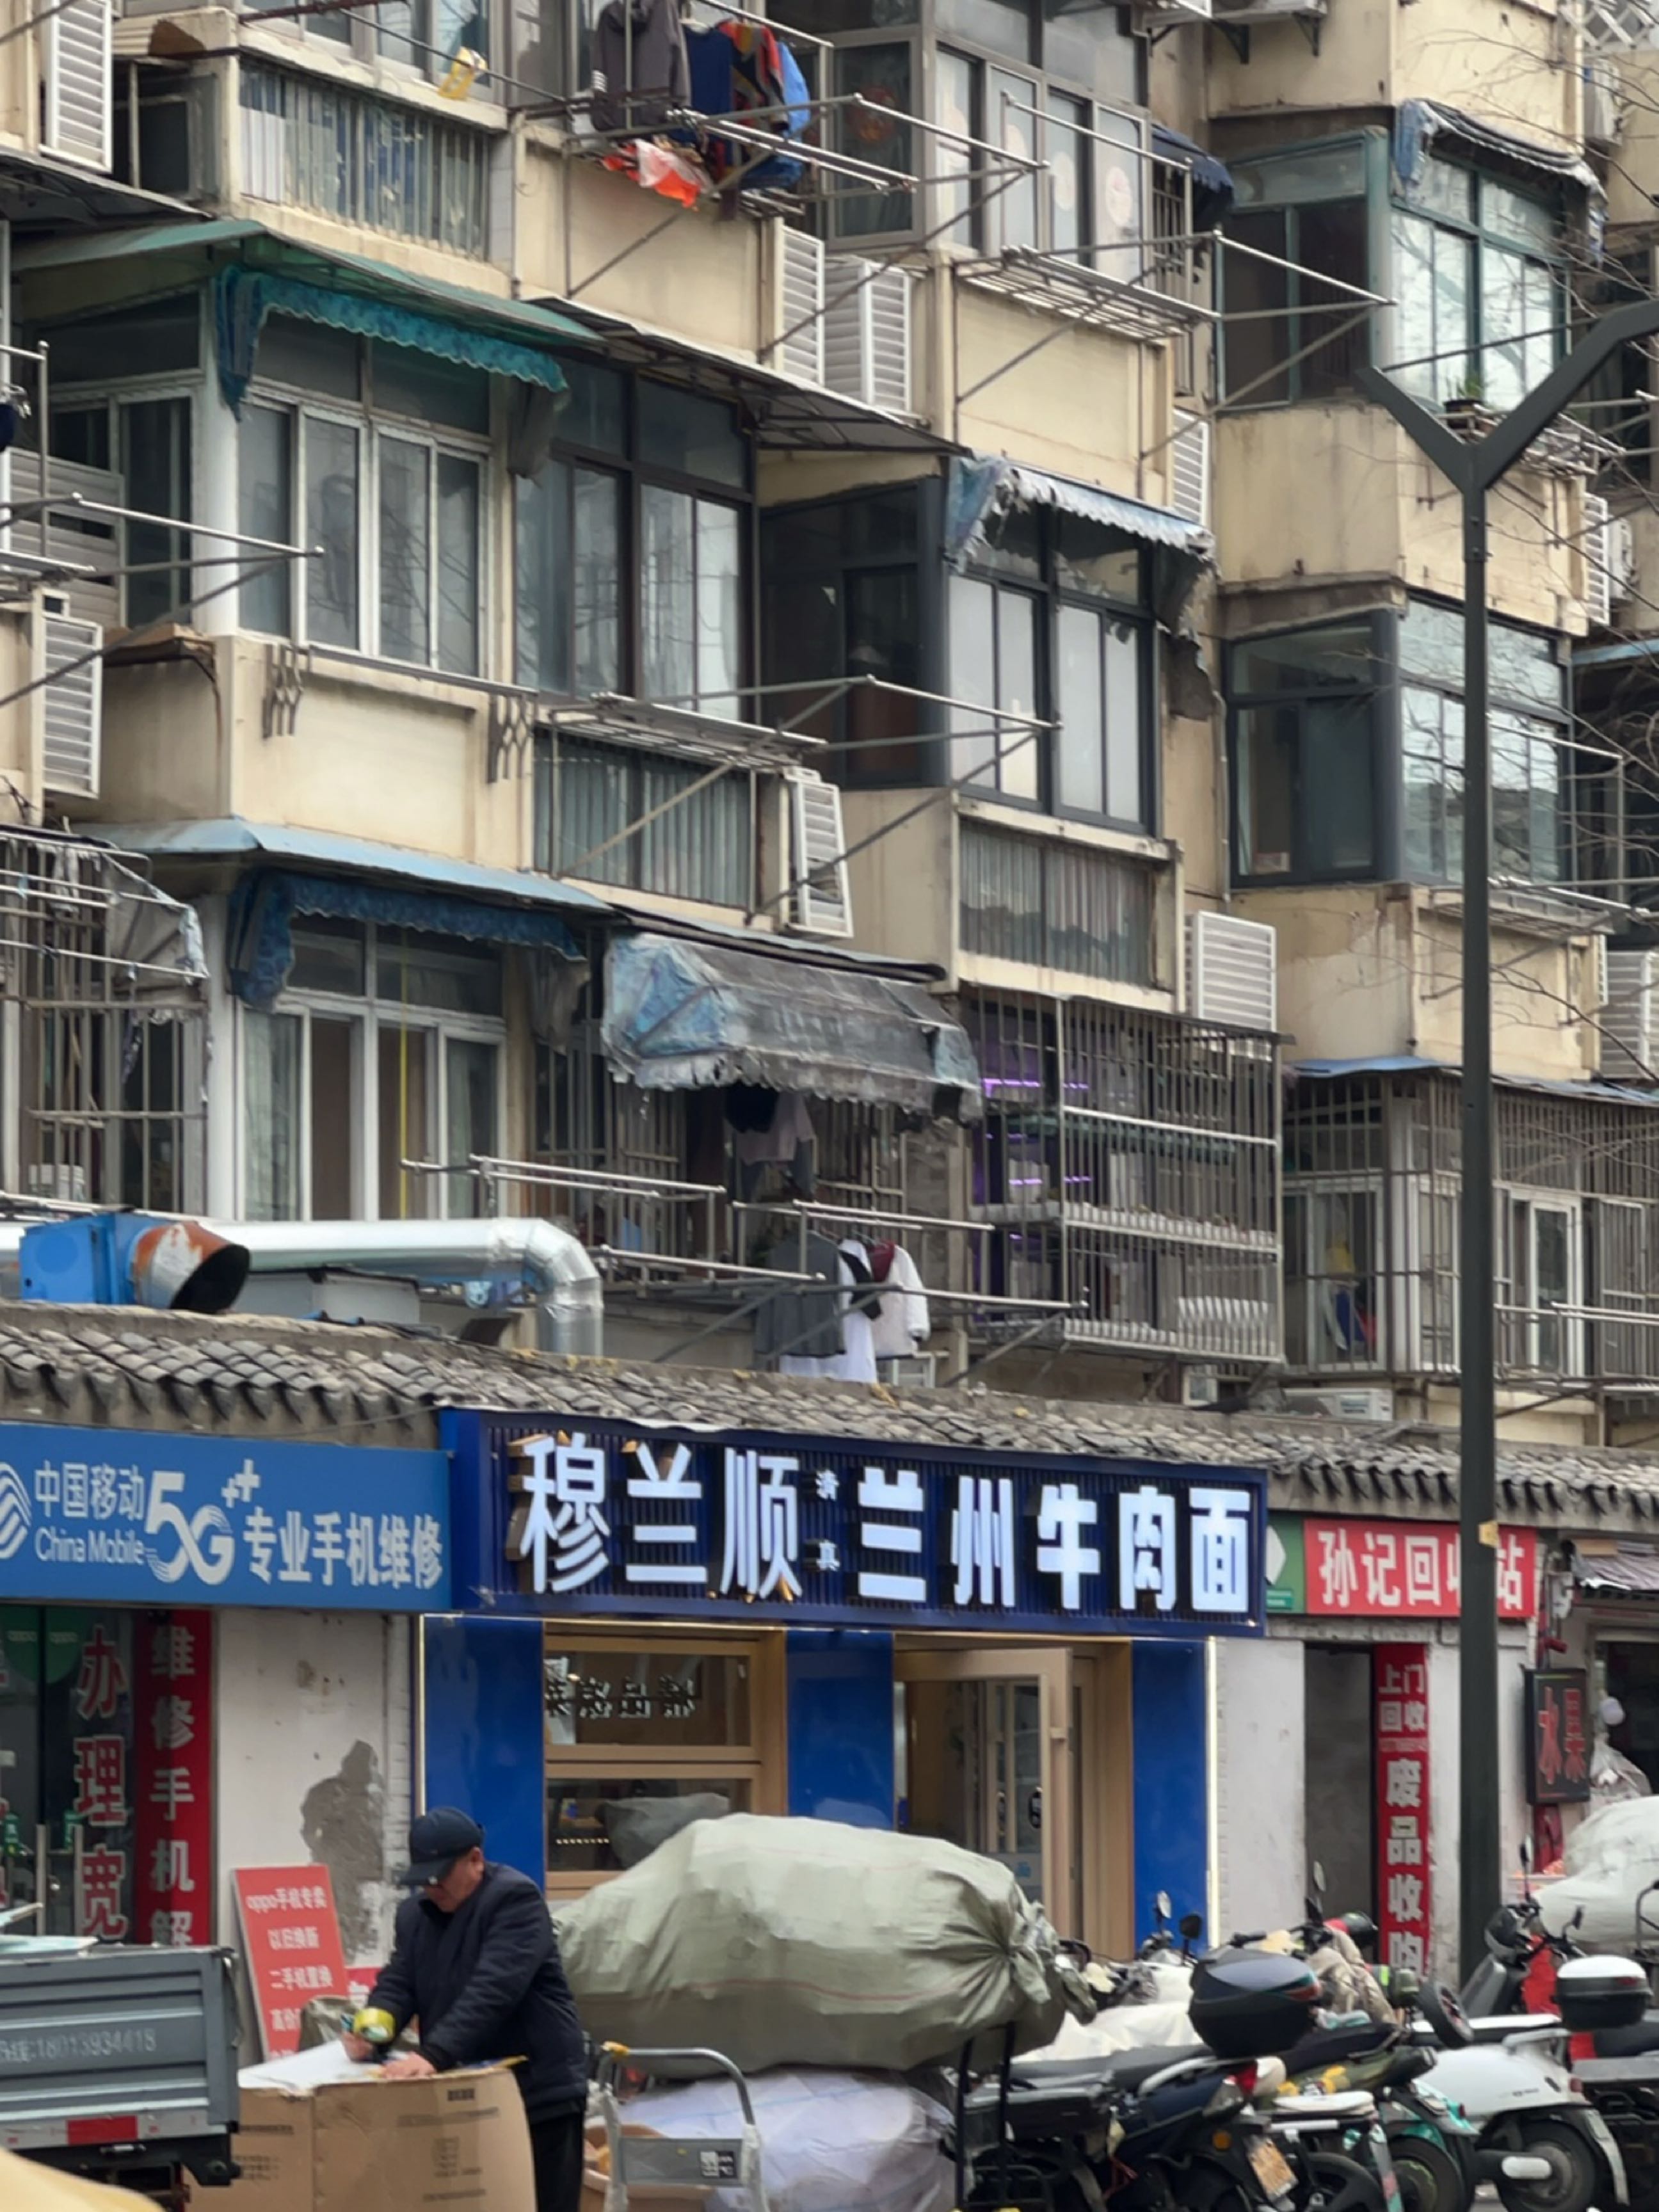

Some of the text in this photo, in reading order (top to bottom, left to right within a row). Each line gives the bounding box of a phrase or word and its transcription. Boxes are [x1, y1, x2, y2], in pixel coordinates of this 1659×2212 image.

[35, 1460, 145, 1521] 中国移动
[517, 1432, 803, 1599] 穆兰顺
[815, 1469, 840, 1572] 清真
[35, 1527, 145, 1566] China Mobile
[243, 1506, 444, 1590] 专业手机维修
[858, 1466, 1251, 1613] 兰州牛肉面
[1378, 1663, 1425, 1694] 上门
[1379, 1700, 1426, 1732] 回收
